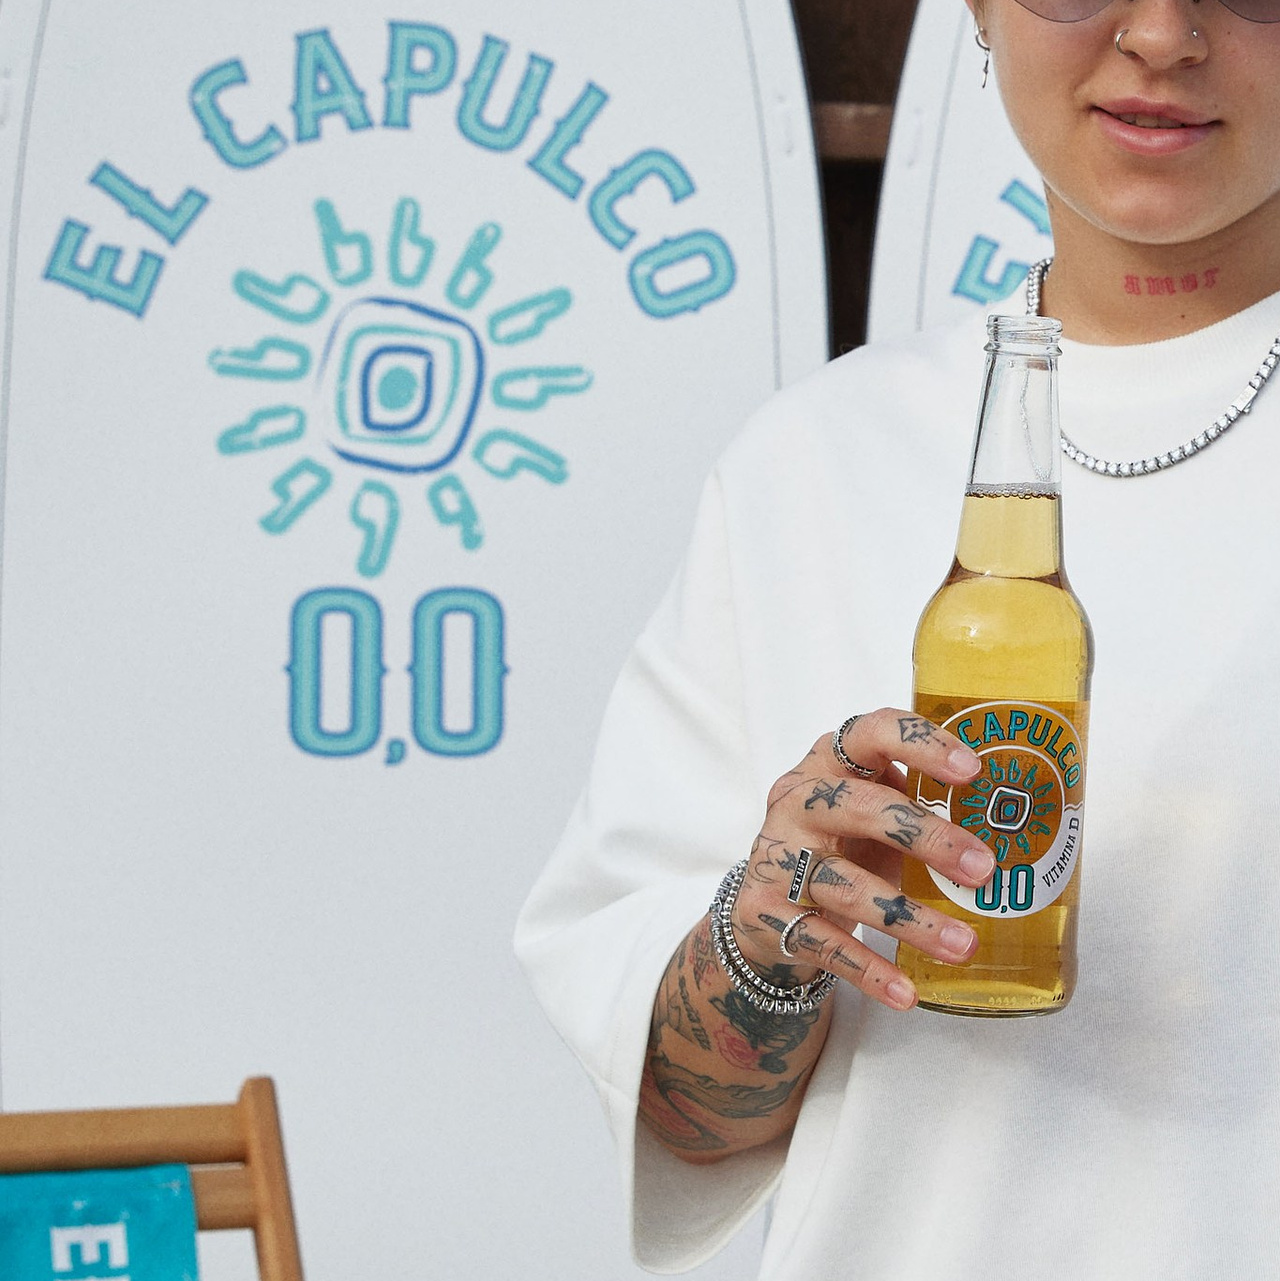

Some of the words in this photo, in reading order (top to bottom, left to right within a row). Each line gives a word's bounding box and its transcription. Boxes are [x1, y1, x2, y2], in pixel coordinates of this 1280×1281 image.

[42, 160, 211, 319] EL
[187, 19, 737, 320] CAPULCO
[284, 586, 510, 766] 0,0
[957, 709, 1081, 789] CAPULCO
[1041, 834, 1078, 888] VITAMINA
